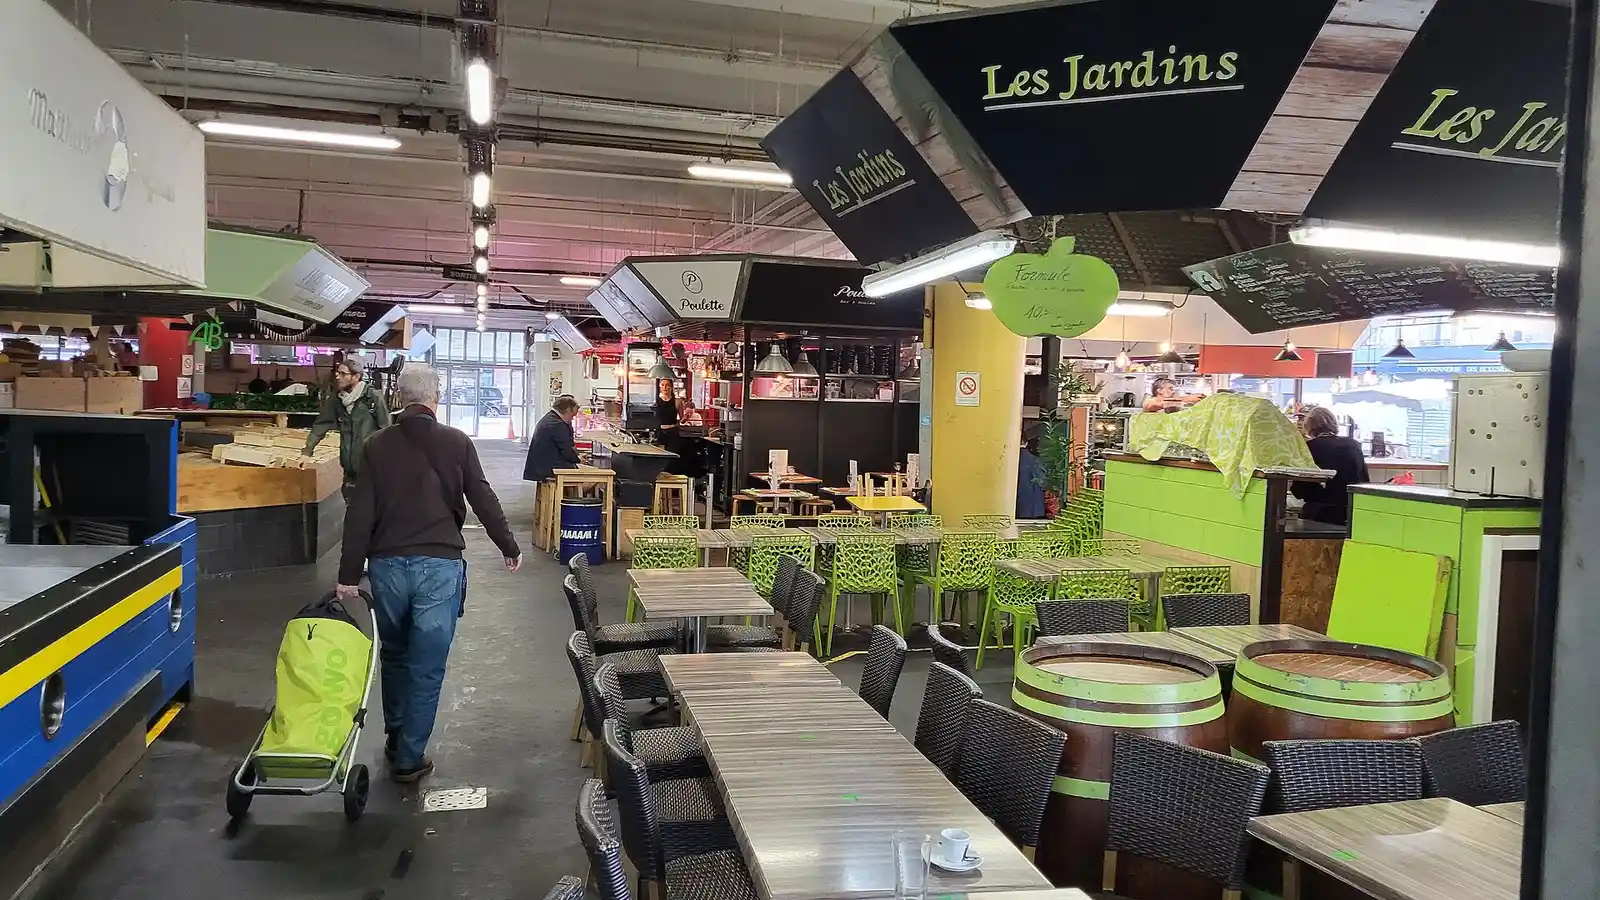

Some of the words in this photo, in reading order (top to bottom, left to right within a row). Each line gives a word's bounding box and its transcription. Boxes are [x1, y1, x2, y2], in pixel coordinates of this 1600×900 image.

[981, 64, 1050, 100] Les
[1059, 45, 1239, 100] Jardins
[1401, 88, 1496, 143] Les
[1479, 102, 1567, 158] Jar
[812, 179, 850, 210] Les
[835, 149, 906, 205] Jardins
[1014, 262, 1074, 282] Formule
[679, 298, 726, 312] Poulette
[188, 321, 223, 350] AB
